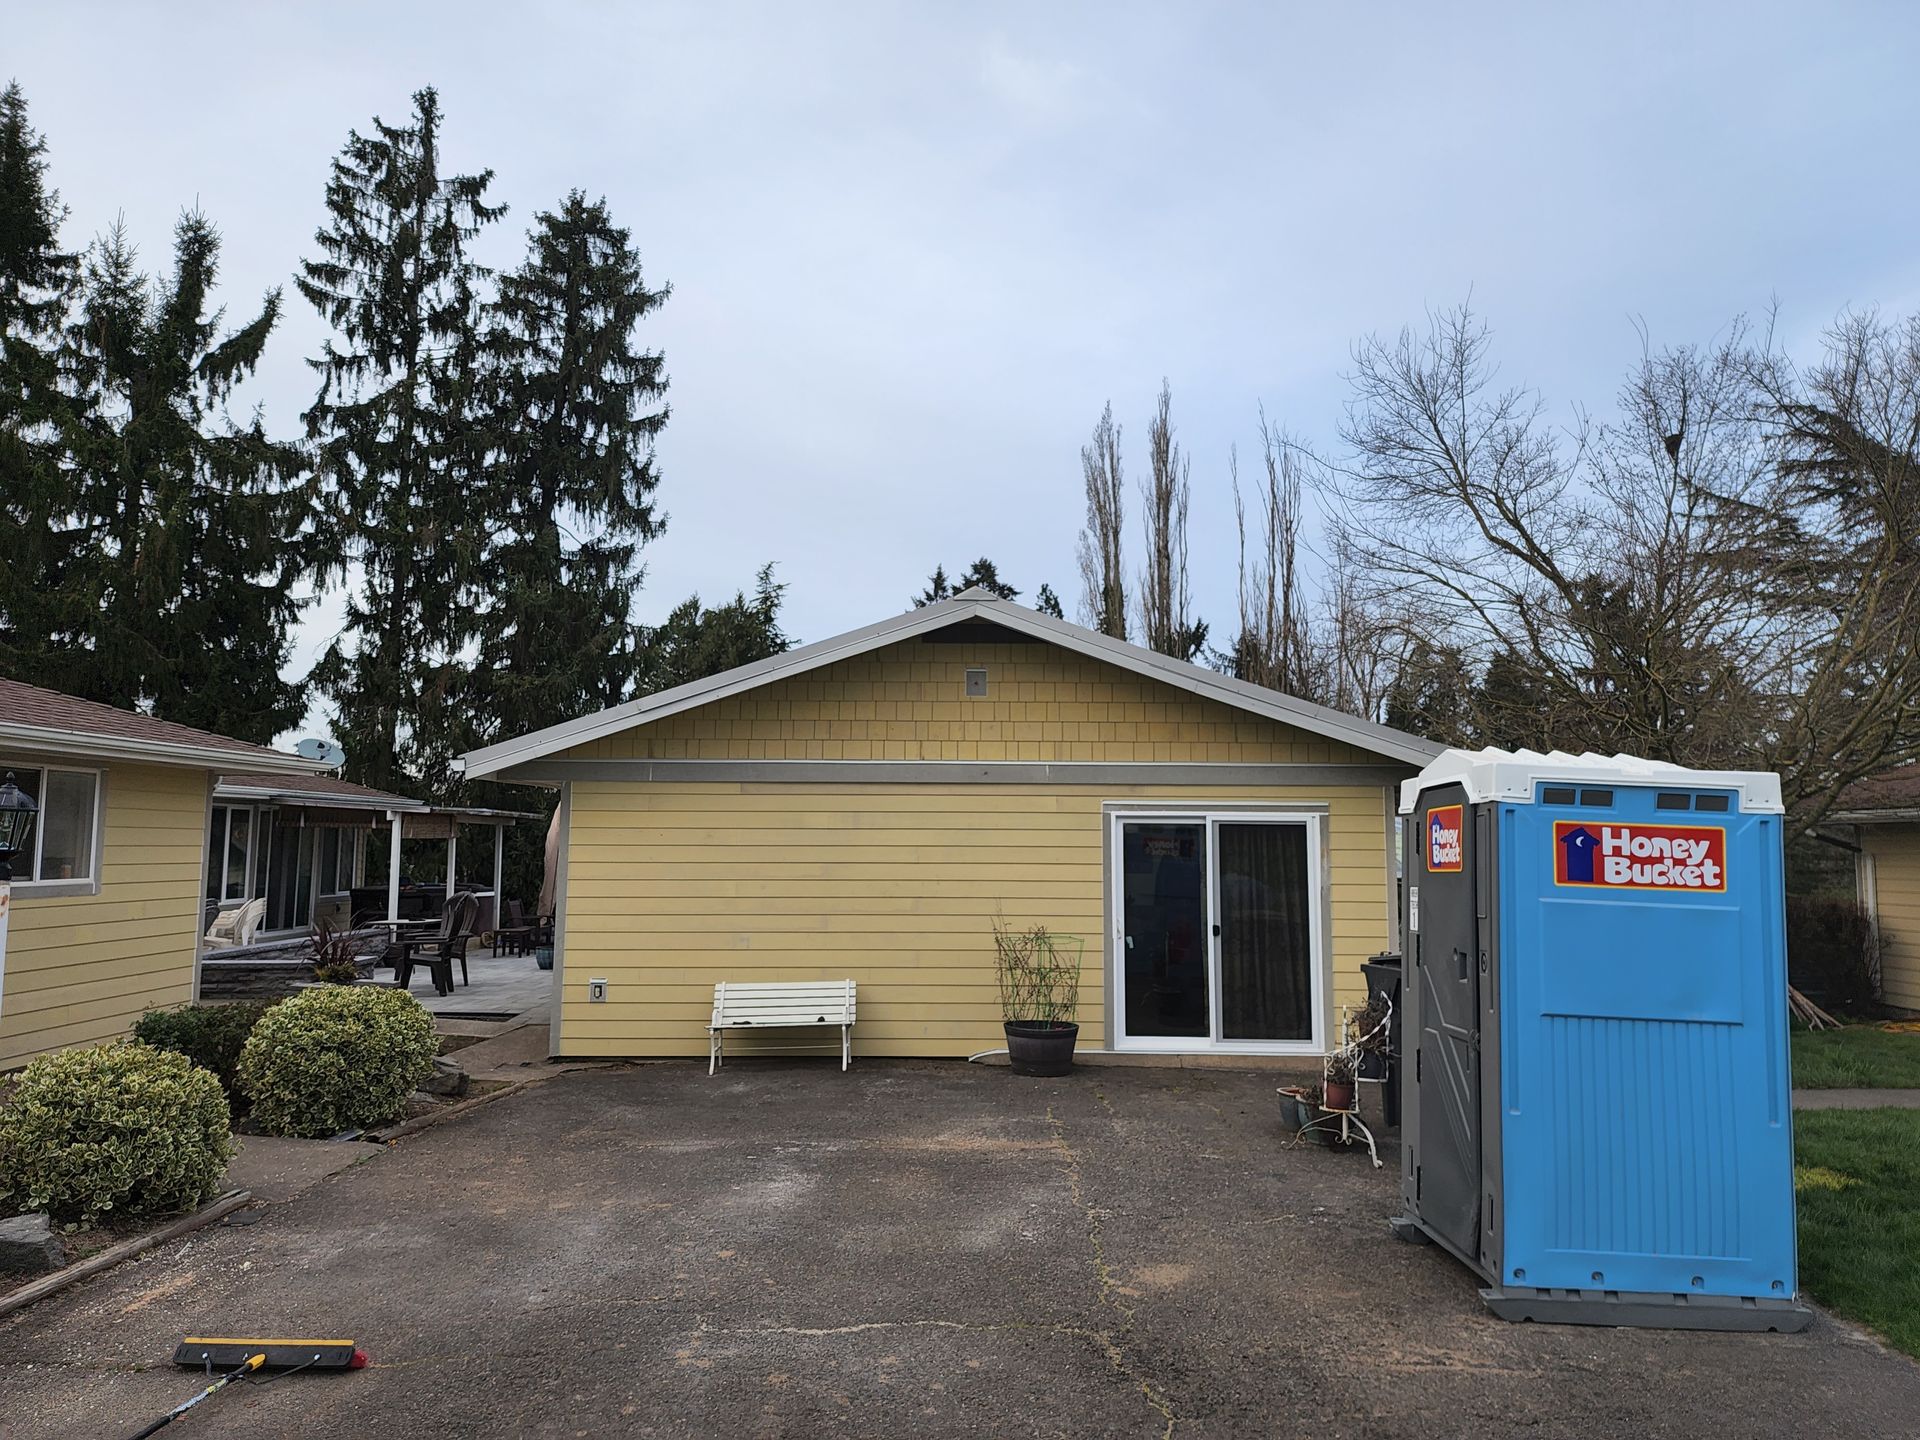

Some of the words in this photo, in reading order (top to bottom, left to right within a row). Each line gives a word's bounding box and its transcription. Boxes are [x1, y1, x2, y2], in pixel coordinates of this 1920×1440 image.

[1432, 824, 1459, 848] Honey
[1602, 827, 1710, 865] Honey
[1433, 843, 1460, 863] Bucket
[1604, 857, 1720, 886] Bucket
